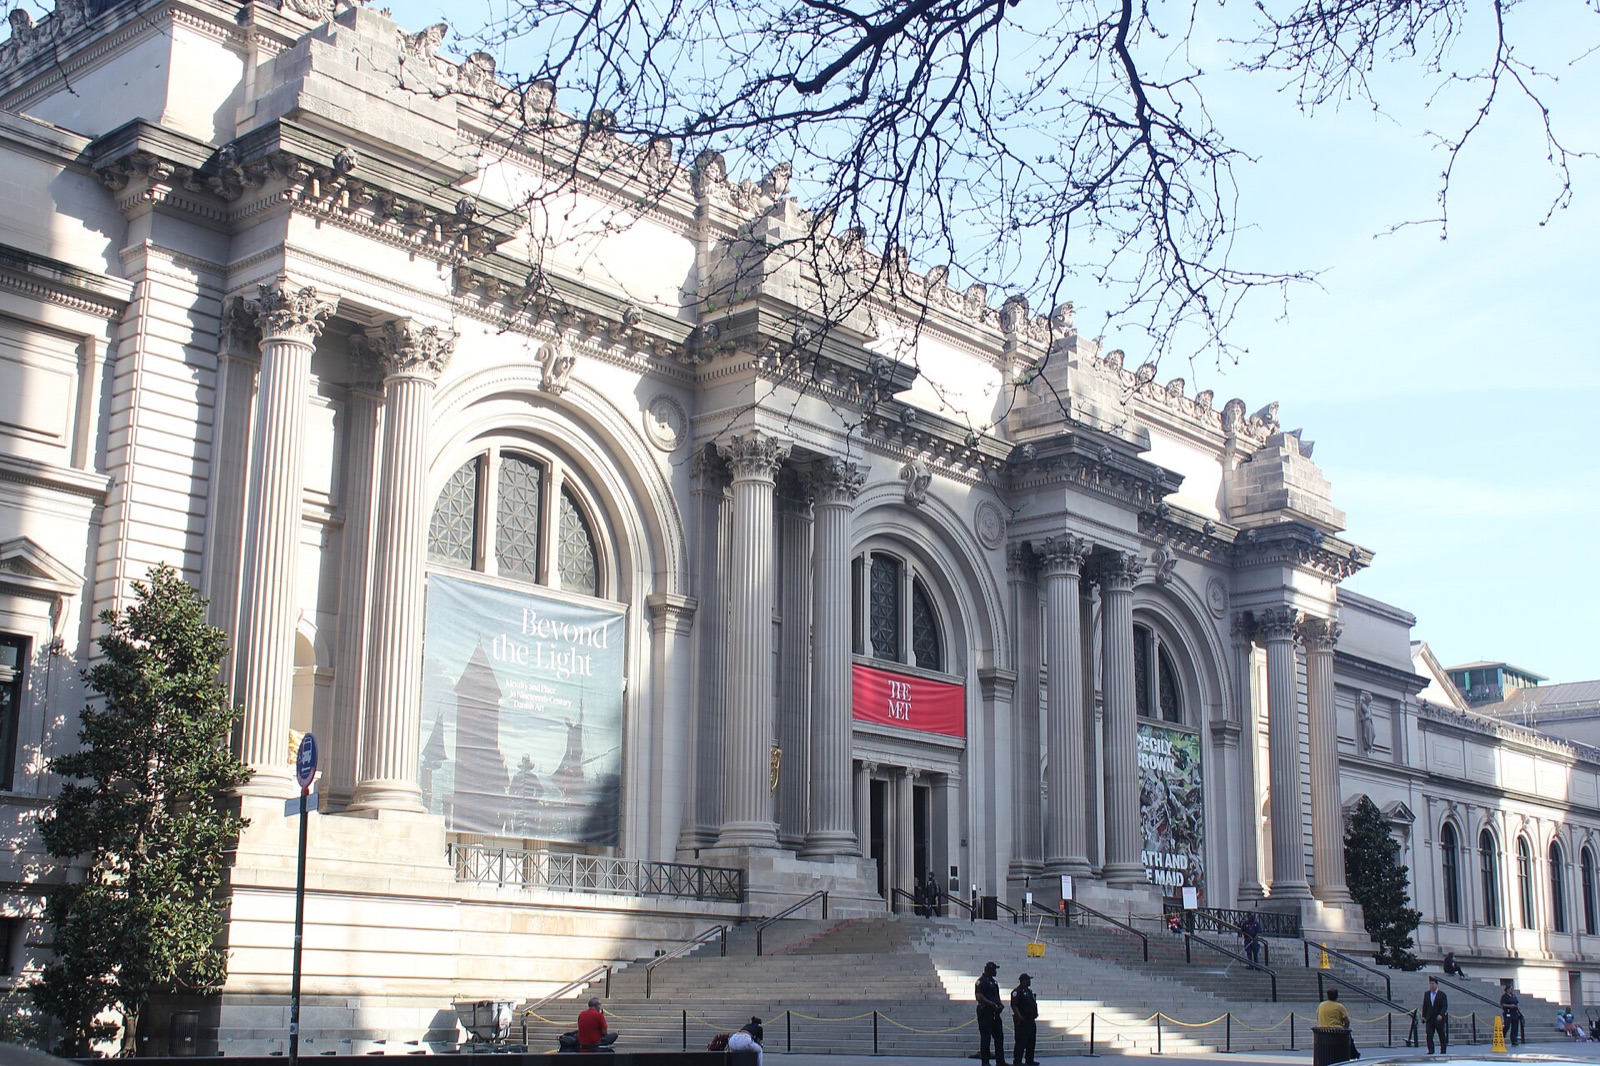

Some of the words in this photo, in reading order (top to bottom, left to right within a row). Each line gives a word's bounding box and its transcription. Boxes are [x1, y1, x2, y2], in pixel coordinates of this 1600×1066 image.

[521, 608, 608, 649] Beyond
[491, 634, 529, 665] the
[536, 642, 593, 680] Light
[505, 679, 529, 690] Identity
[529, 683, 541, 692] and
[888, 680, 912, 702] THE
[513, 700, 534, 710] Danish
[888, 699, 912, 721] MET
[1142, 850, 1163, 868] ATH
[1165, 853, 1188, 870] AND
[1155, 869, 1184, 887] MAID
